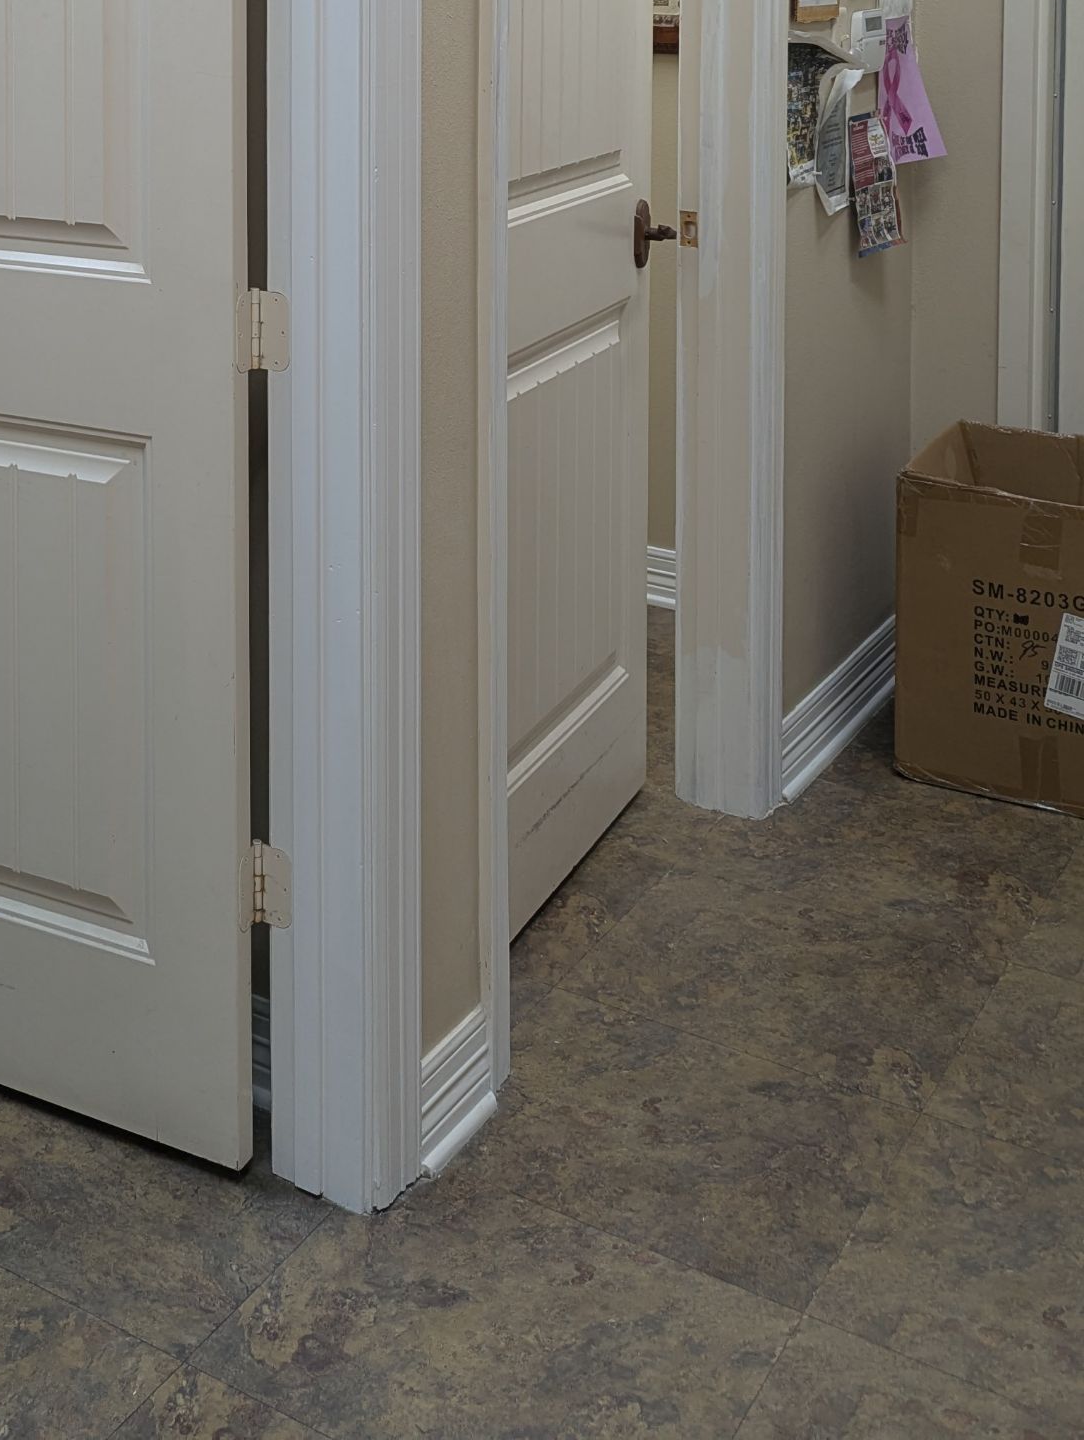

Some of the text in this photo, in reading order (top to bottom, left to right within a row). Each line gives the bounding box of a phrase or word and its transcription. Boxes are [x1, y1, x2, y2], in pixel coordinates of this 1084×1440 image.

[974, 605, 1010, 623] QTY:
[974, 633, 1011, 650] CTN:
[974, 647, 1014, 665] N.W.:
[975, 661, 1015, 678] G.W.:
[975, 689, 991, 702] 50
[996, 693, 1005, 705] X
[1010, 697, 1026, 709] 43
[1032, 701, 1040, 712] X
[973, 702, 1018, 722] MADE
[1026, 713, 1042, 727] IN
